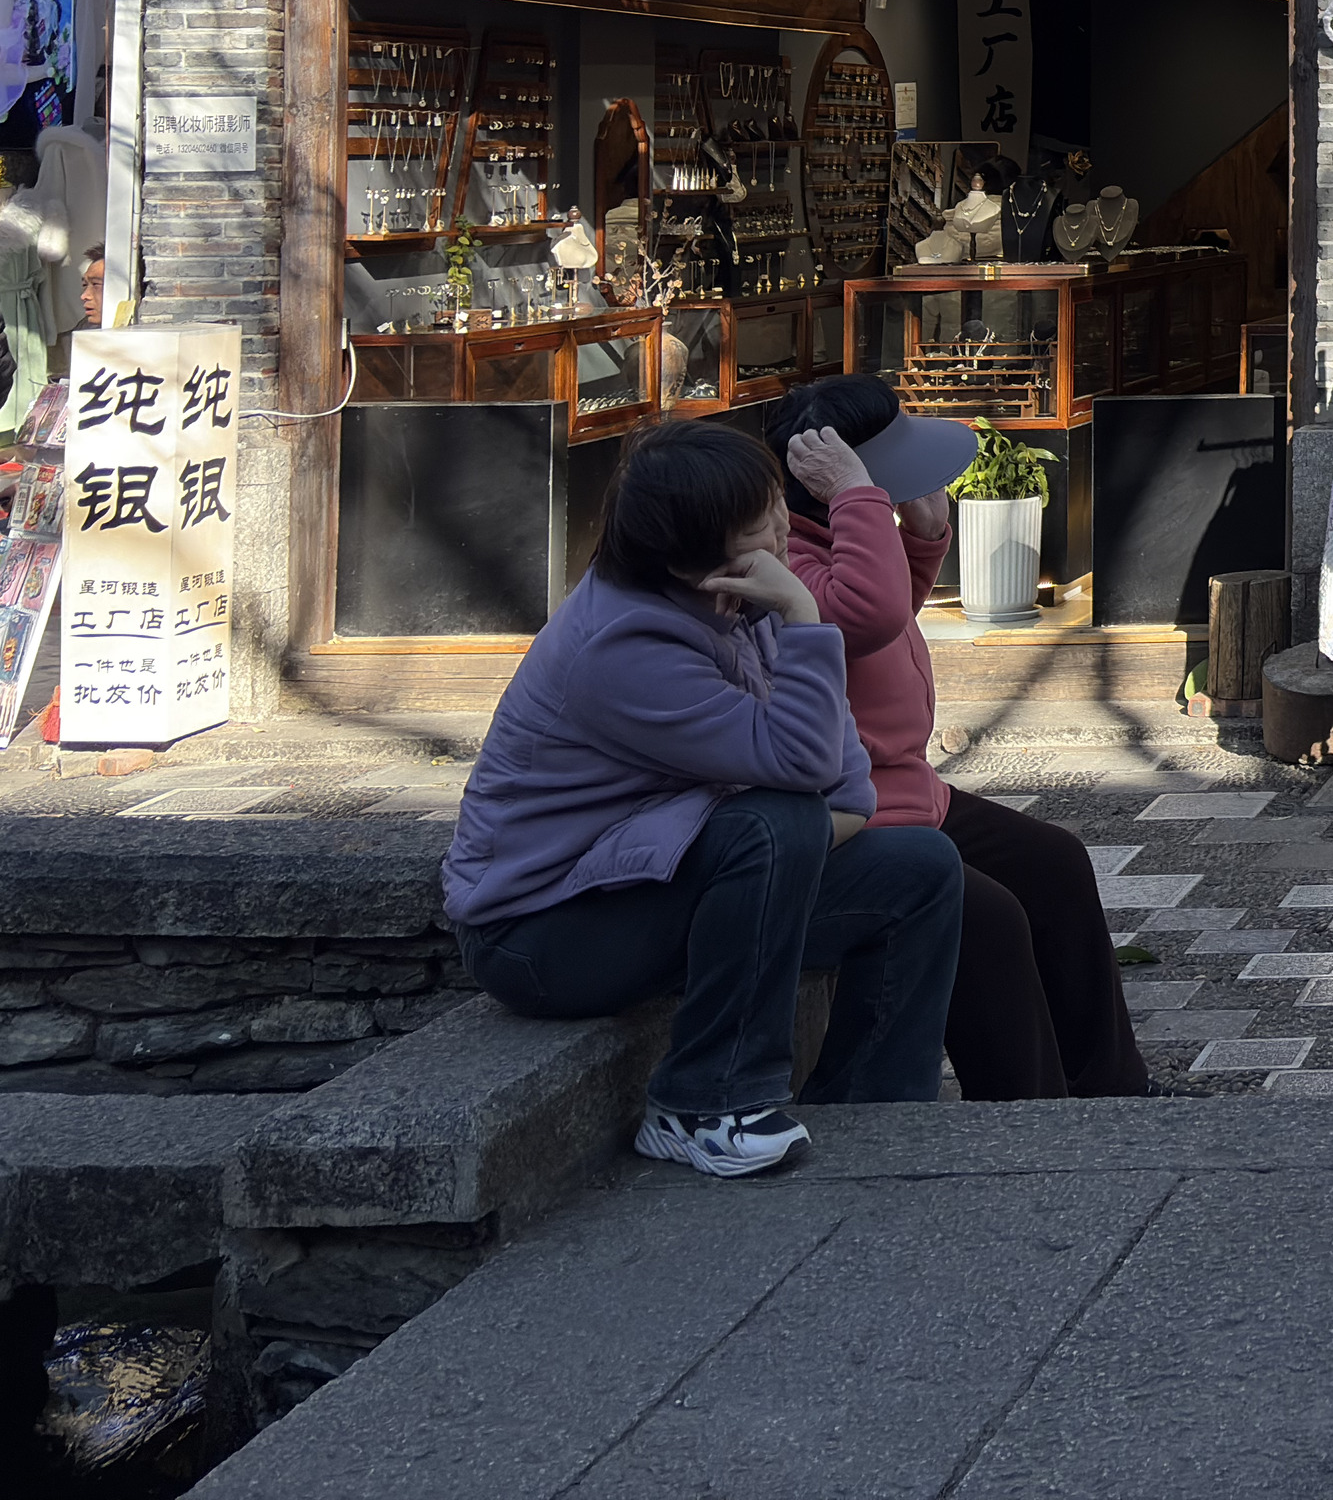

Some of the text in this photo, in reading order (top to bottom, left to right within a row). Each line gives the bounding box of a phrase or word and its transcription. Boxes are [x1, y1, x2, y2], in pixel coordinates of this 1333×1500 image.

[153, 114, 251, 134] 招聘化妆师摄影师
[219, 142, 249, 154] 微信同号
[74, 366, 169, 534] 纯银
[178, 362, 233, 531] 纯银
[79, 579, 160, 598] 星河锻造
[179, 569, 226, 594] 星河锻造
[71, 607, 165, 630] 工厂店
[174, 593, 228, 629] 工厂店
[75, 657, 158, 674] 一件也是
[177, 642, 223, 667] 一件也是
[74, 683, 163, 706] 批发价
[176, 667, 226, 702] 批发价
